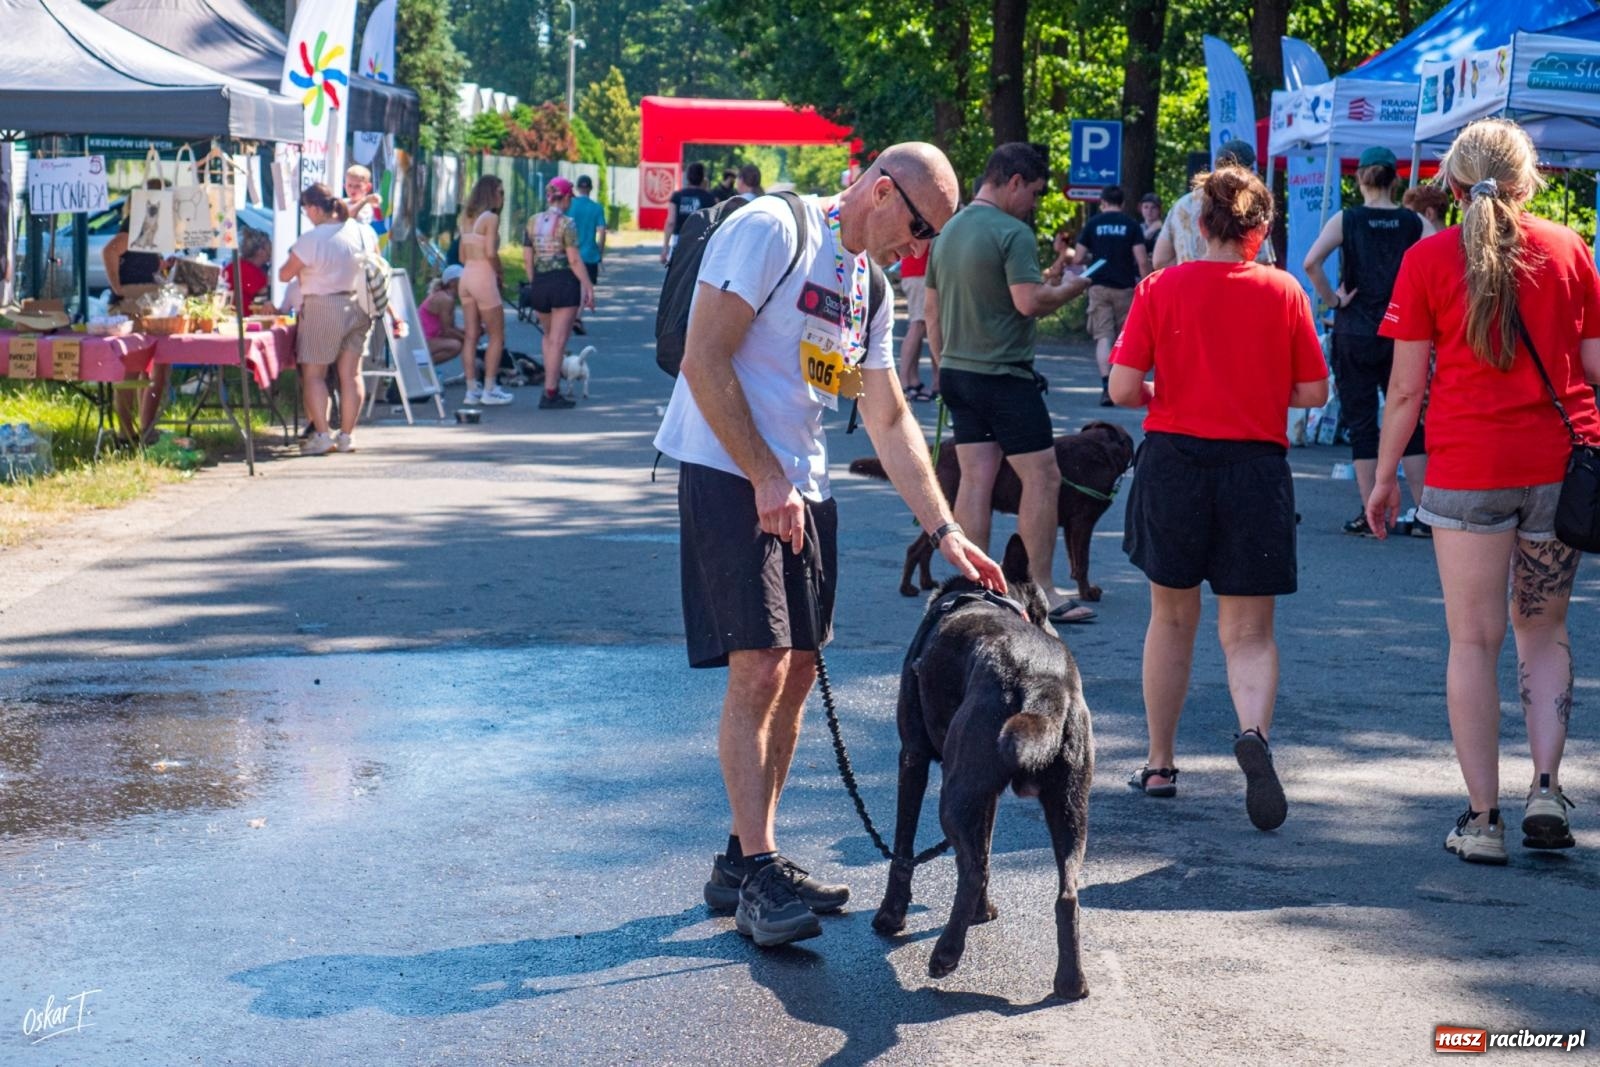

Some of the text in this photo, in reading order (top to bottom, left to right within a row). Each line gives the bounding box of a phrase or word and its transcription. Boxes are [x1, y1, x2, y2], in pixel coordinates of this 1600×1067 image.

[1381, 99, 1418, 107] KRAJOW
[1081, 126, 1111, 163] P
[808, 356, 835, 386] 006
